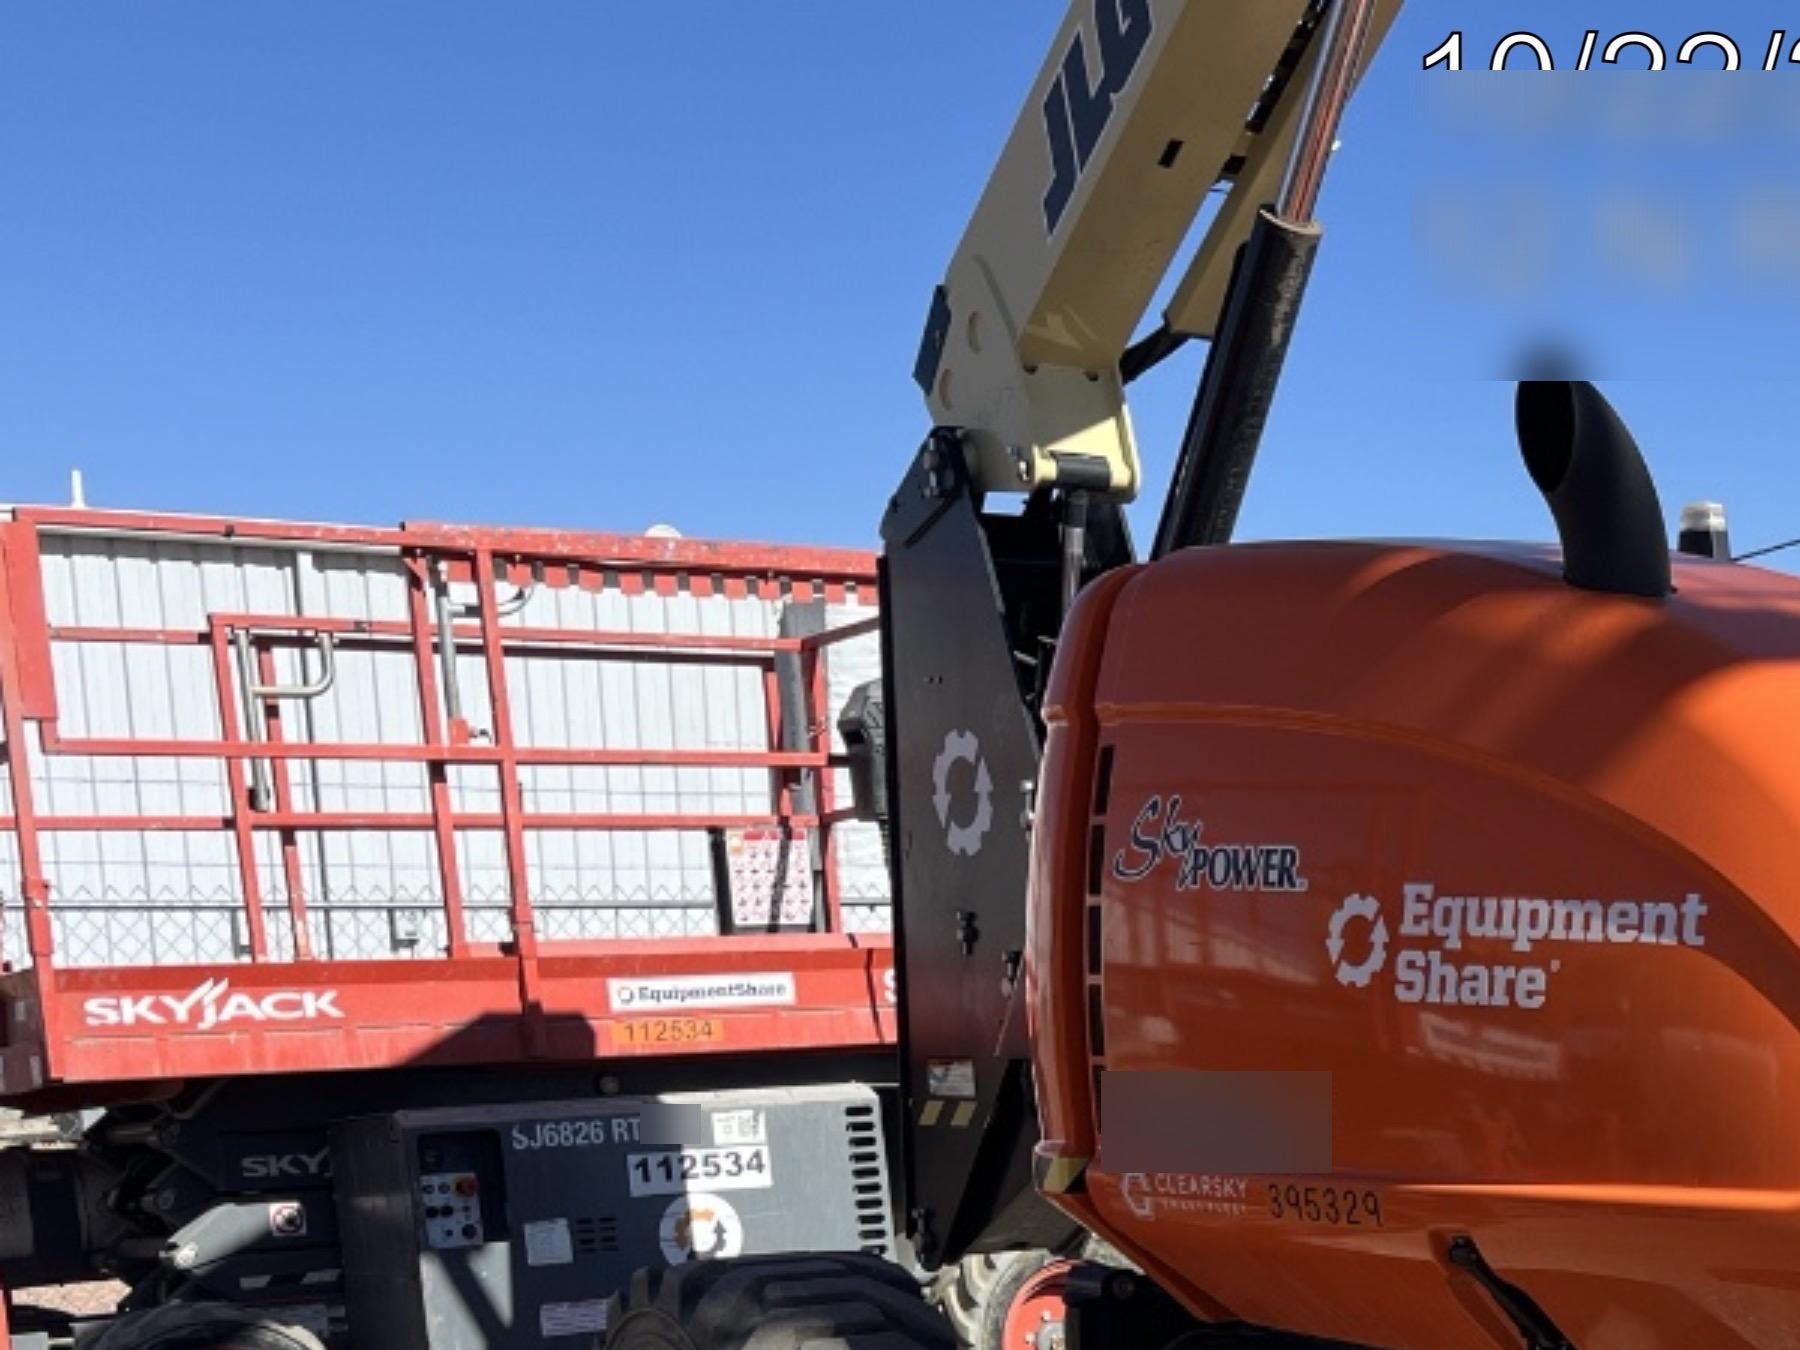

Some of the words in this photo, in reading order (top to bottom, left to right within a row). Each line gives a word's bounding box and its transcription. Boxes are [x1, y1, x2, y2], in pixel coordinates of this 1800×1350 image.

[1113, 794, 1203, 891] Sky
[1187, 845, 1303, 891] POWER
[1400, 882, 1708, 951] Equipment
[638, 981, 787, 1003] EquipmentShare
[1394, 949, 1548, 1009] Share
[83, 977, 344, 1031] SKYJACK
[625, 1018, 714, 1042] 112534
[511, 1119, 605, 1150] SJ6826
[634, 1149, 766, 1183] 112534
[1154, 1173, 1249, 1199] CLEARSKY
[1268, 1184, 1383, 1227] 395329
